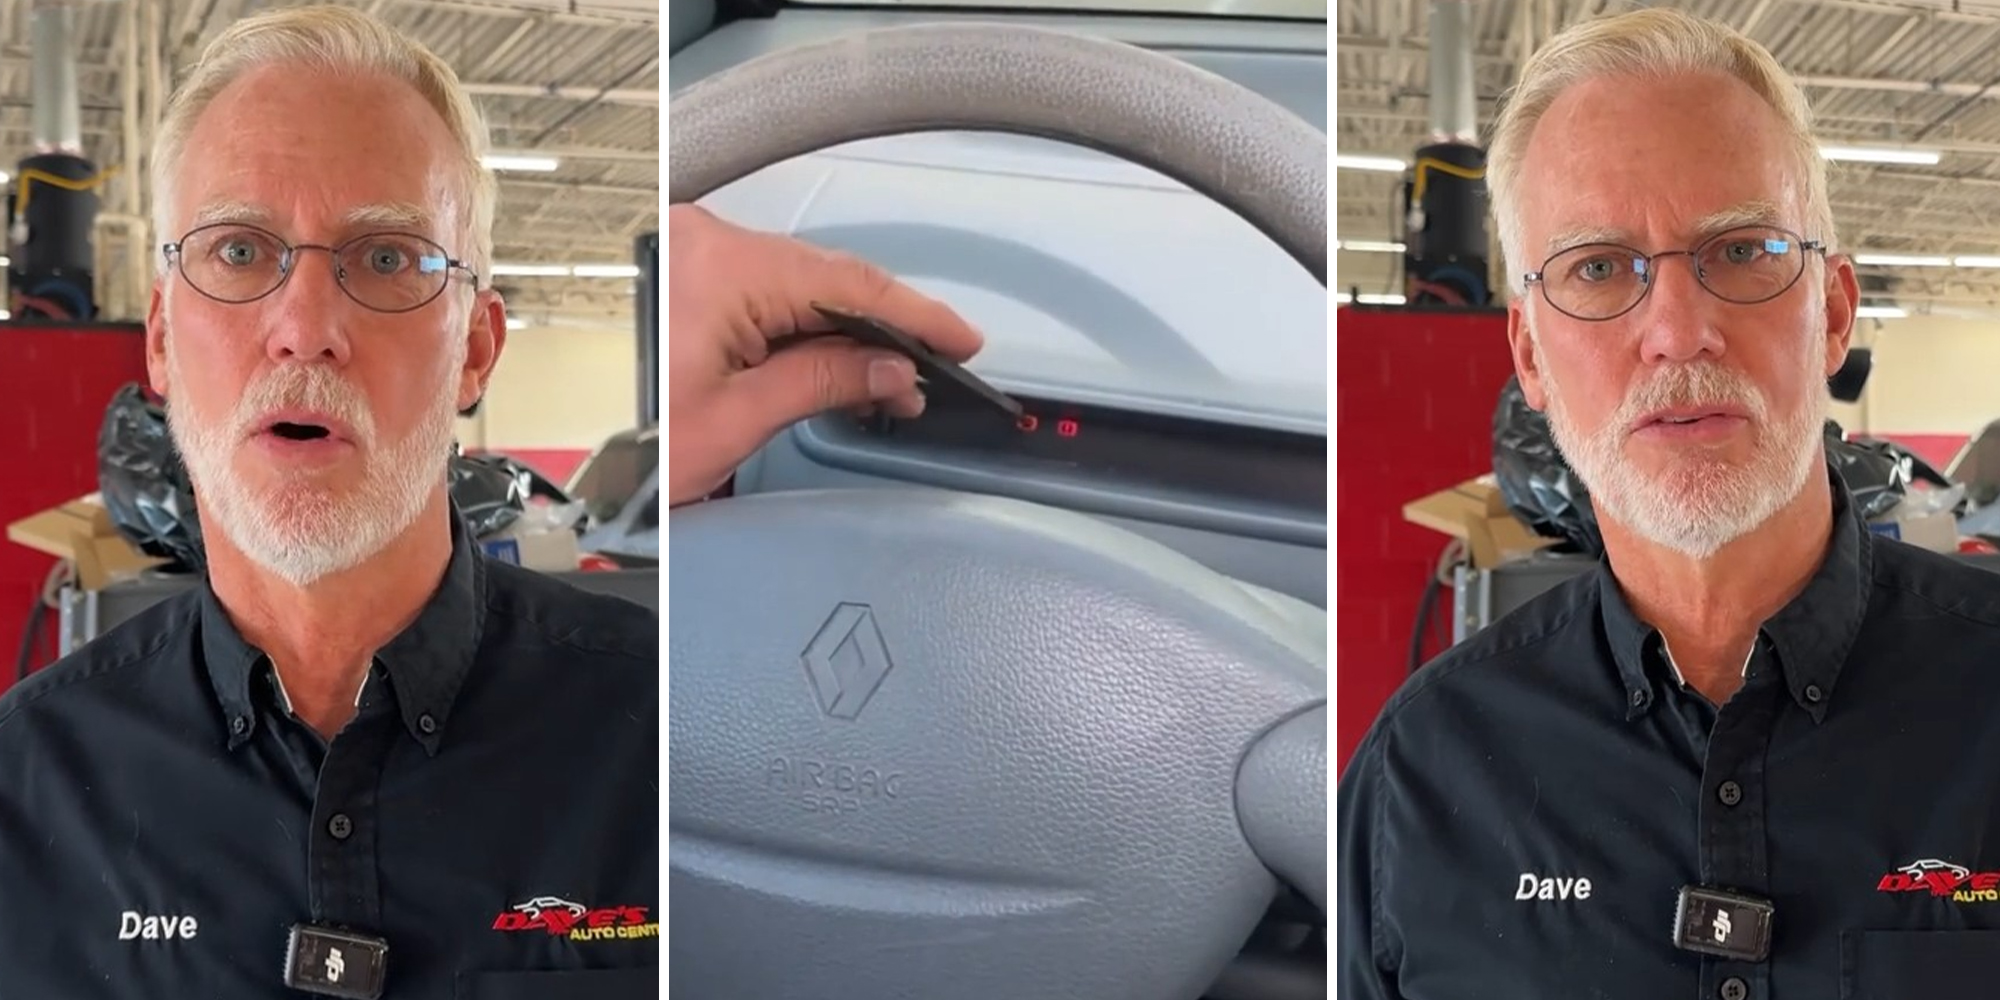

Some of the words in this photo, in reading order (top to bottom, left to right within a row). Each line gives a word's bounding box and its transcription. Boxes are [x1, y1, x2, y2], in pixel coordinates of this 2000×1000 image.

[1515, 872, 1592, 900] Dave
[1952, 889, 1999, 902] AUTO
[118, 910, 198, 940] Dave
[492, 906, 649, 934] DAVE'S
[569, 926, 616, 940] AUTO
[616, 923, 659, 939] CENT
